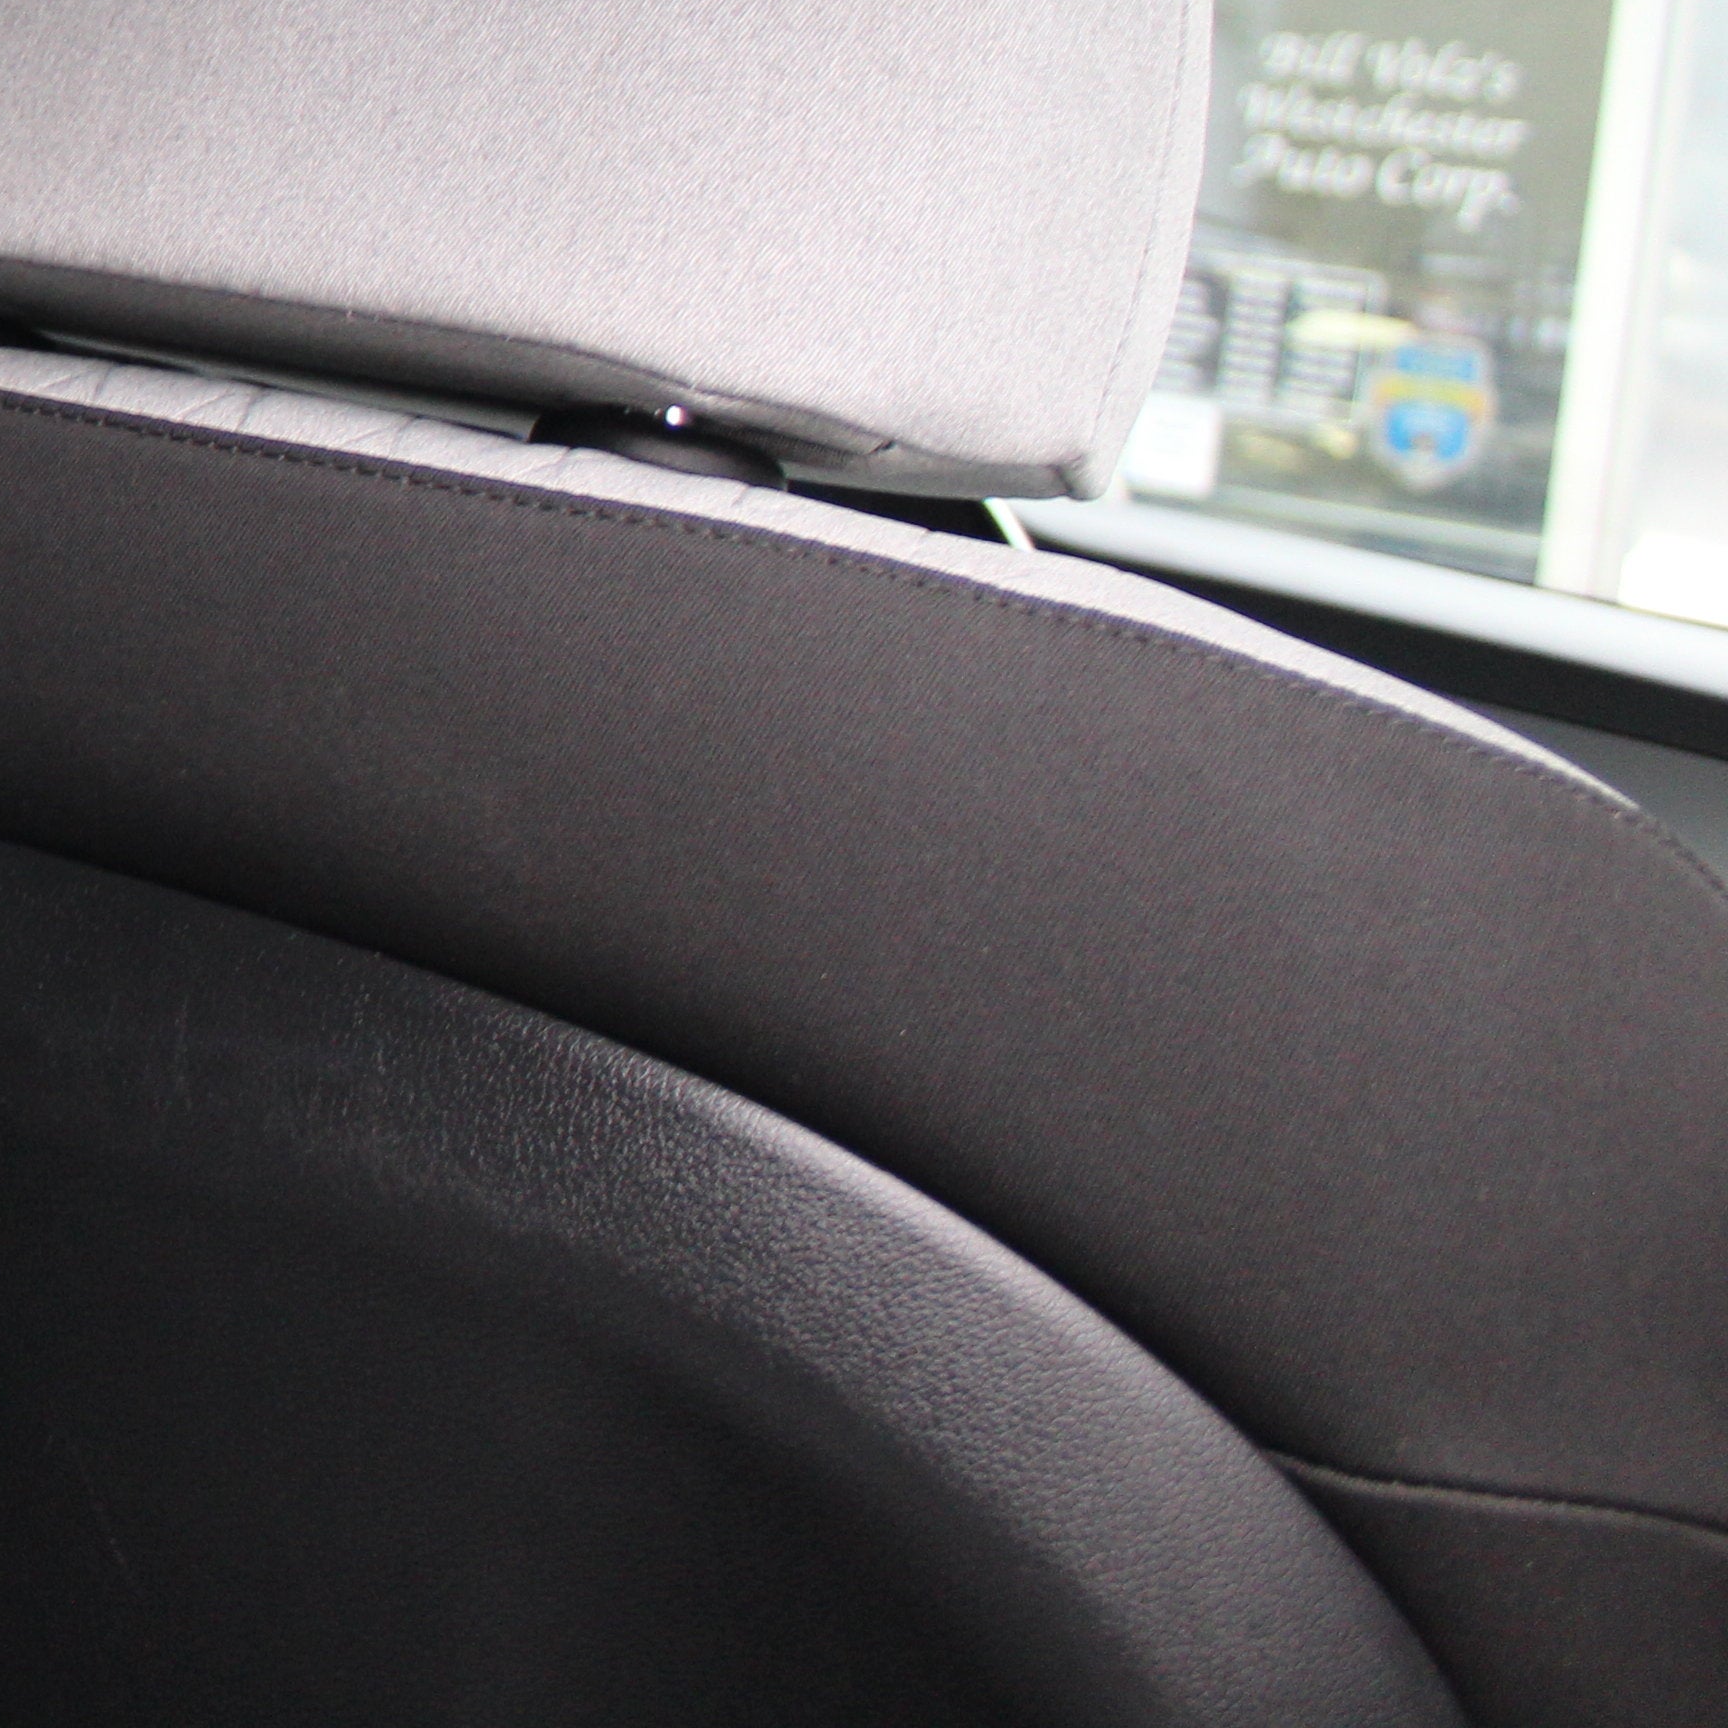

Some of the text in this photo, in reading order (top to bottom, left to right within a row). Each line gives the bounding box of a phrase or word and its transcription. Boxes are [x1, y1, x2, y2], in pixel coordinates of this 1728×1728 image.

[1258, 30, 1366, 87] Bill
[1236, 80, 1531, 161] Westchester
[1230, 132, 1521, 234] Auto Corp.
